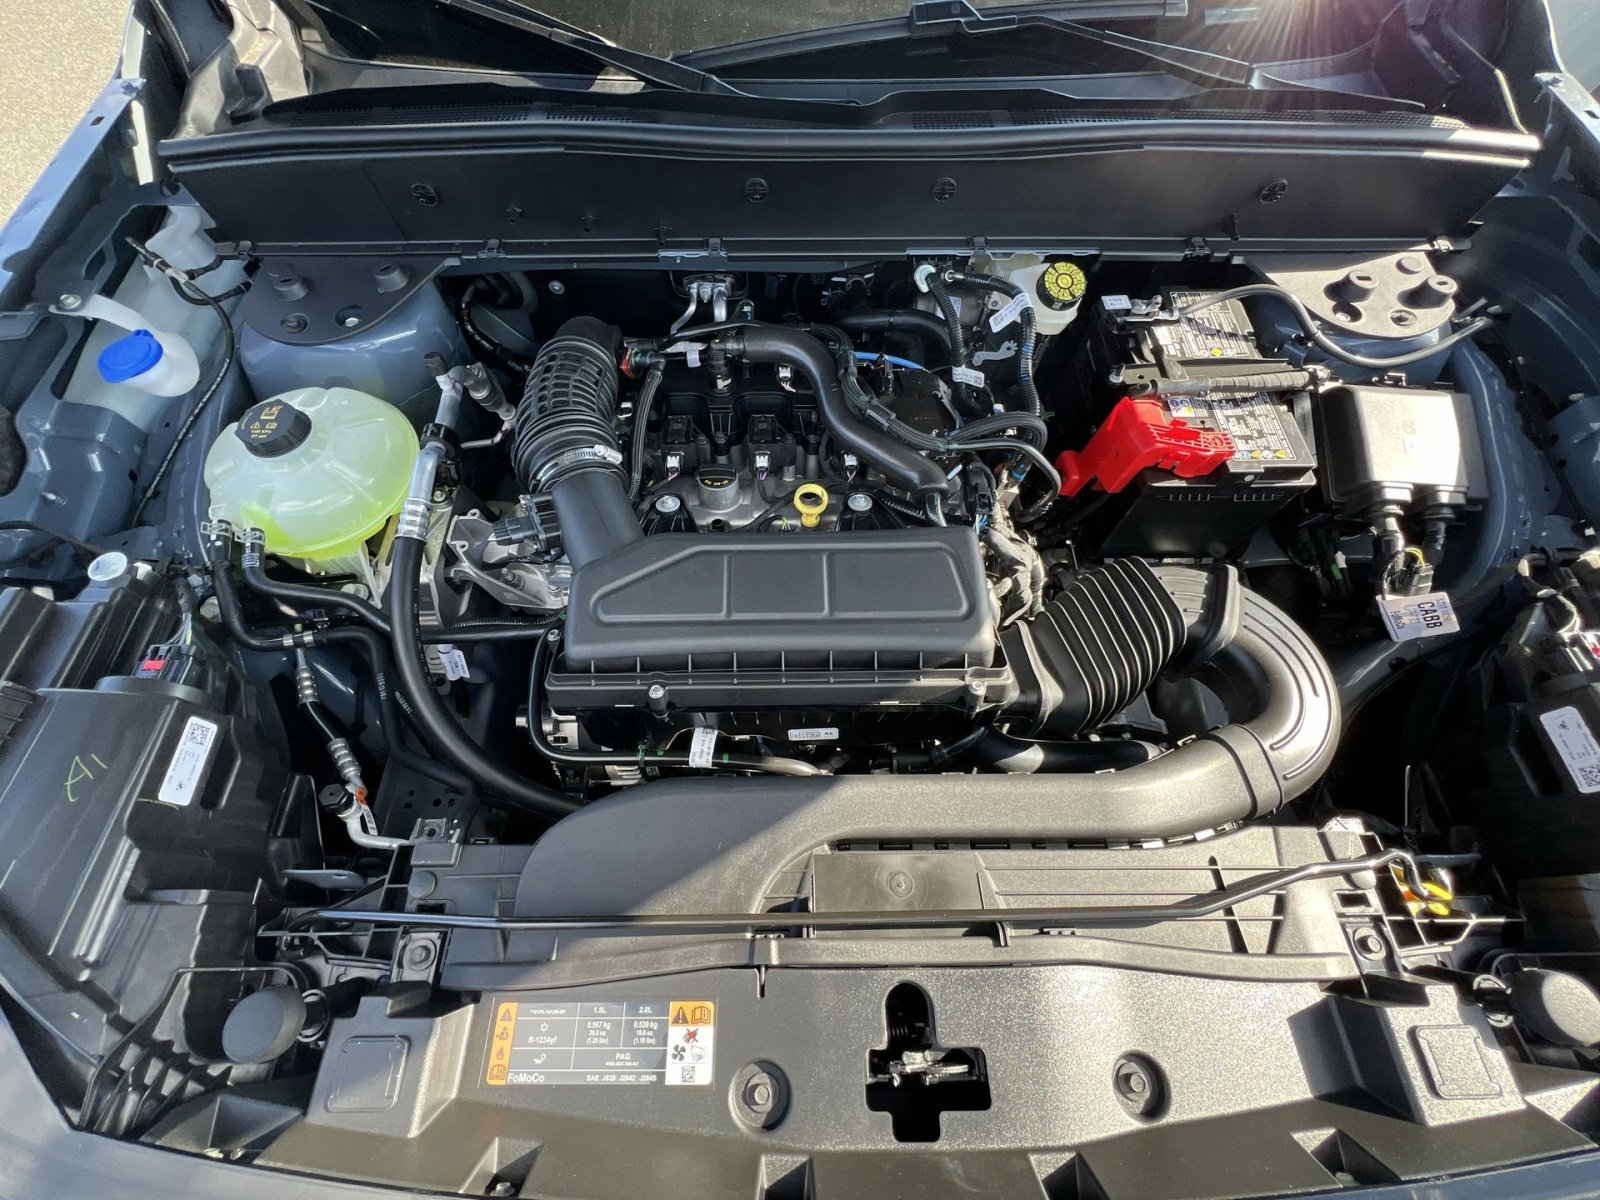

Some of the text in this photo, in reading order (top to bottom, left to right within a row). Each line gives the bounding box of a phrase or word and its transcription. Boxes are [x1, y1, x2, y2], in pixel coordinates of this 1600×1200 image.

[1417, 601, 1443, 629] CABB
[593, 1006, 607, 1014] 1.5L
[638, 1006, 653, 1014] 2.0L
[602, 1021, 611, 1030] kg
[649, 1021, 658, 1030] kg
[528, 1036, 557, 1045] R-1234yf
[615, 1053, 631, 1061] PAG
[507, 1073, 545, 1083] FoMoCo
[586, 1074, 599, 1082] SAE
